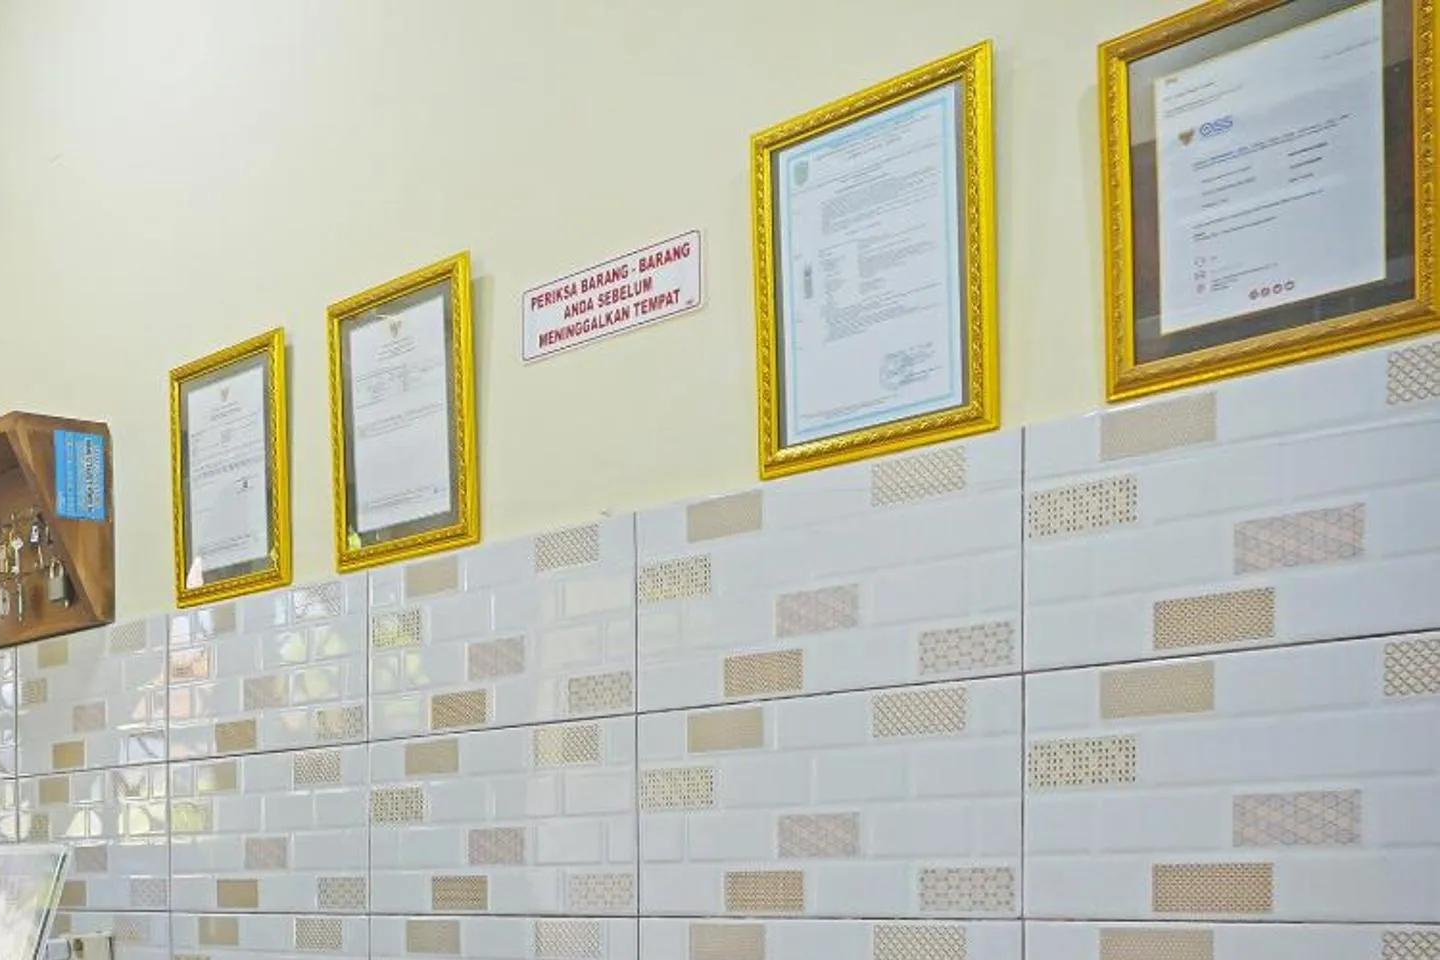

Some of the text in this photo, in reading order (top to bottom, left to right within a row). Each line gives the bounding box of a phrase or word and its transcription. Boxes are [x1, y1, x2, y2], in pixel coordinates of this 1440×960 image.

[531, 282, 577, 312] PERIKSA
[580, 264, 629, 294] BARANG
[638, 242, 691, 273] BARANG
[564, 276, 653, 320] ANDA SEBELUM
[538, 288, 681, 348] MENINGGALKAN TEMPAT
